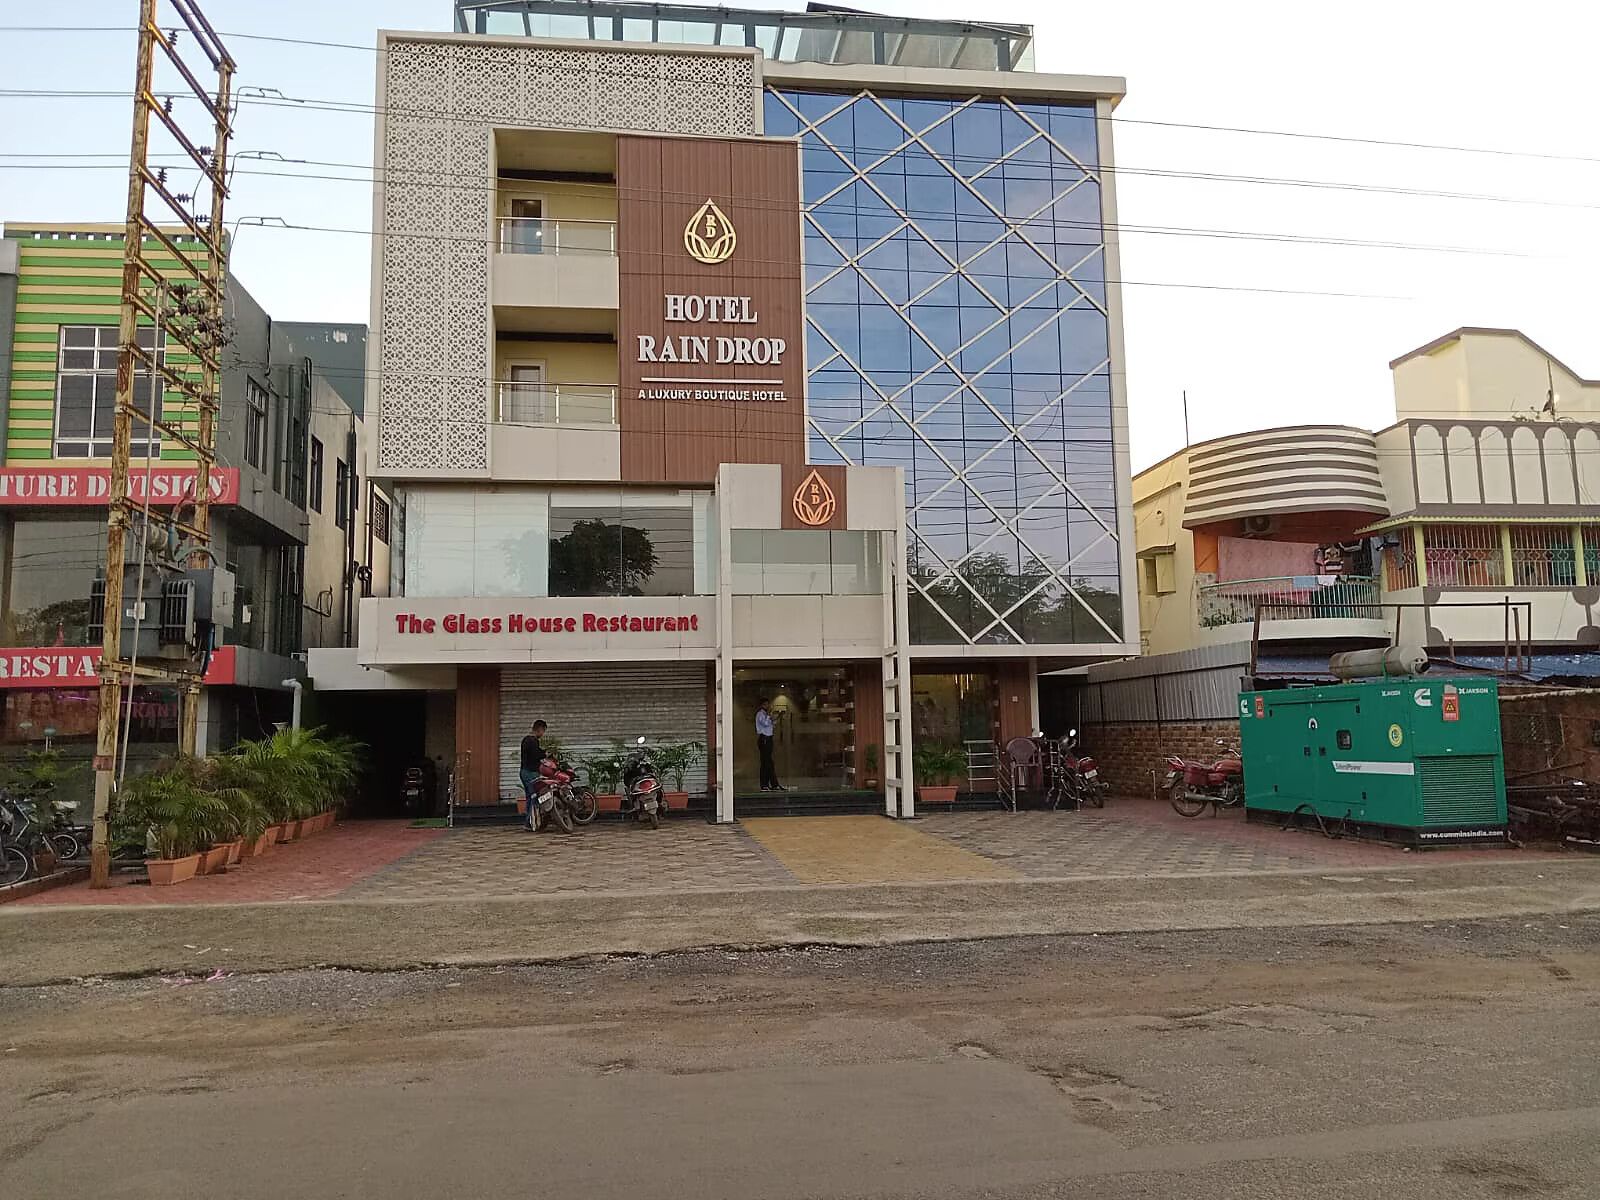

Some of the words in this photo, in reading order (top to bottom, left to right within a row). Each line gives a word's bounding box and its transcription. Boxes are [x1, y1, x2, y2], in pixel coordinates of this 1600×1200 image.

[664, 294, 758, 323] HOTEL
[637, 335, 710, 363] RAIN
[715, 337, 786, 364] DROP
[638, 390, 647, 399] A
[648, 390, 693, 400] LUXURY
[695, 390, 750, 401] BOUTIQUE
[752, 391, 787, 401] HOTEL
[87, 475, 225, 497] DVISION
[396, 614, 436, 633] The
[443, 614, 502, 633] Glass
[508, 614, 577, 633] House
[582, 613, 698, 633] Restaurant
